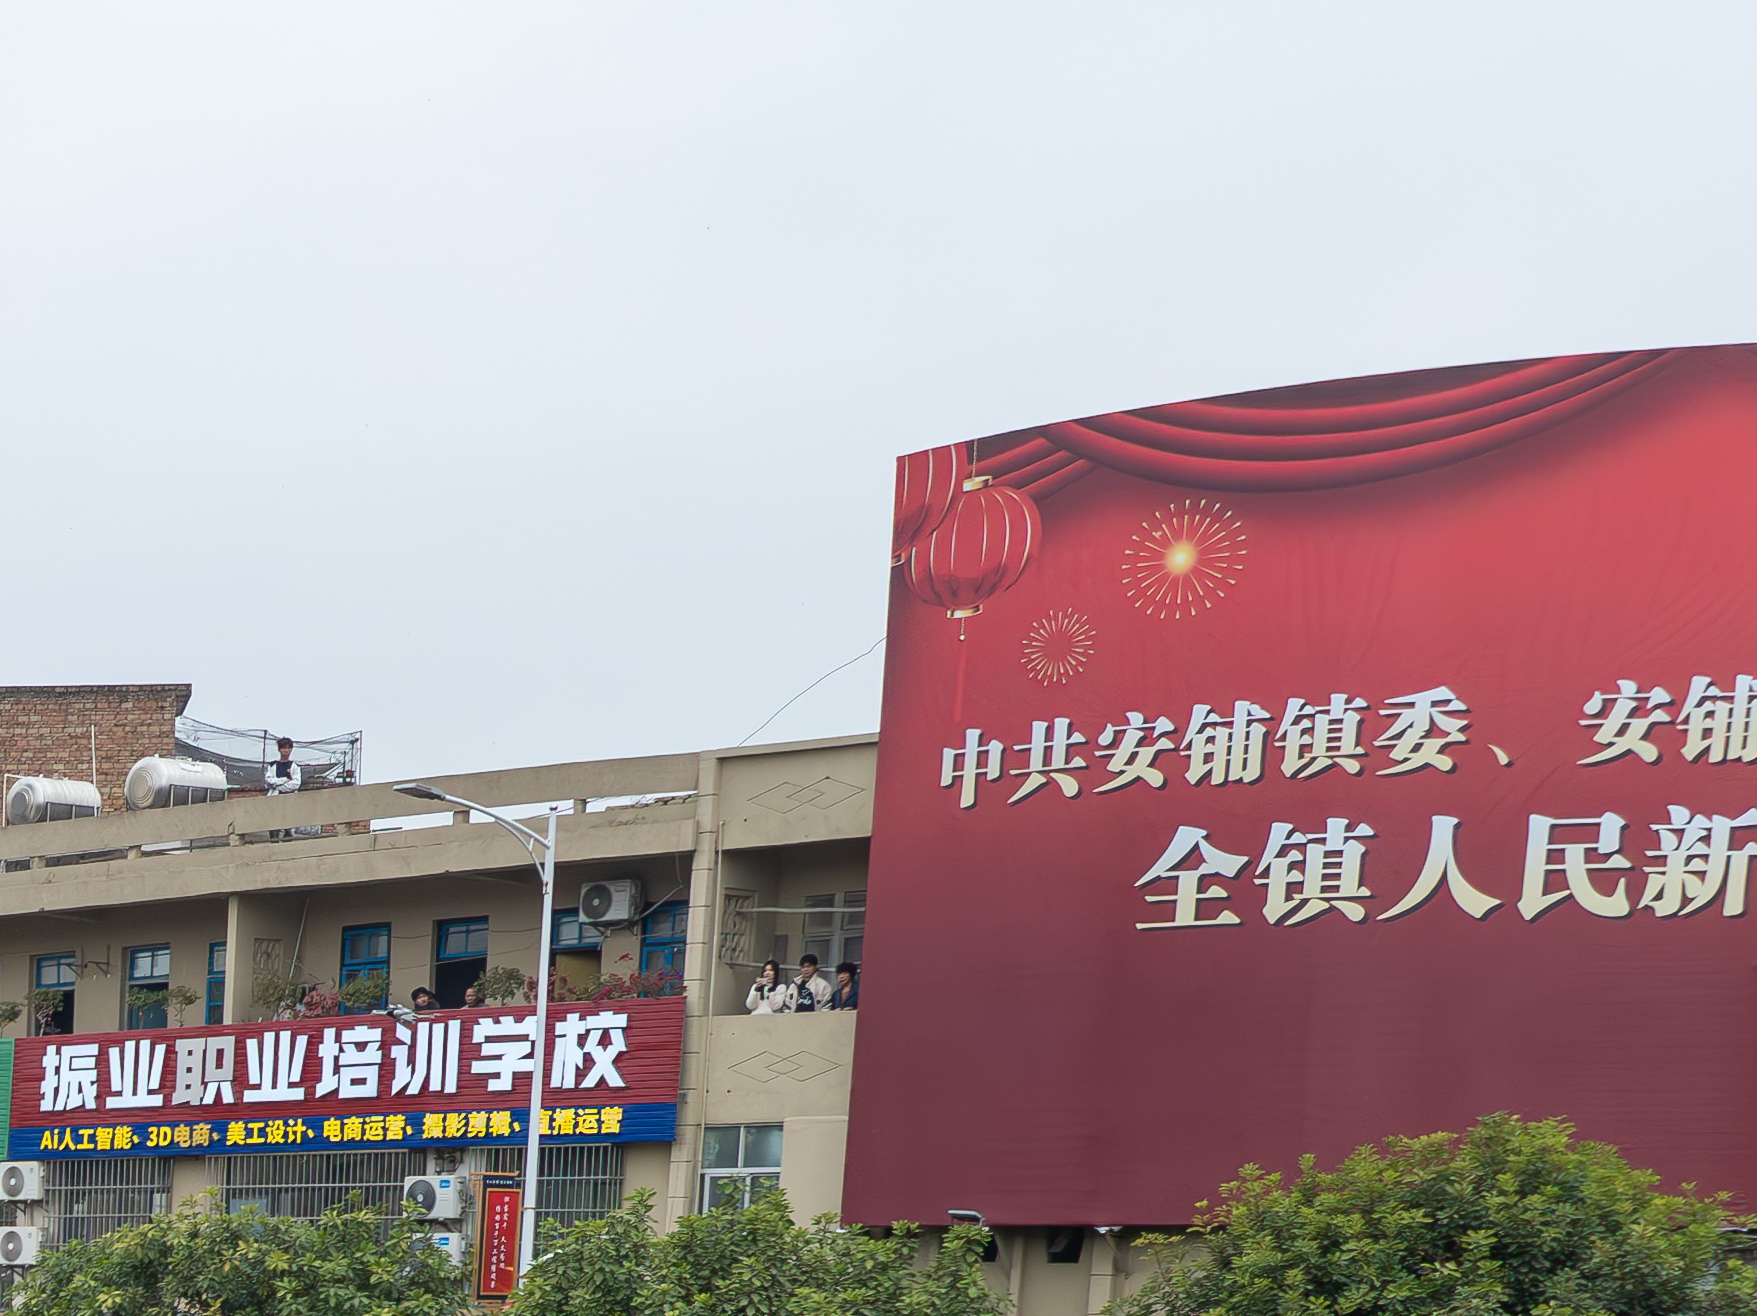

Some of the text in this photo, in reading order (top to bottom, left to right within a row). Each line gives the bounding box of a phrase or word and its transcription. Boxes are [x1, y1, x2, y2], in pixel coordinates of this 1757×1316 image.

[1134, 804, 1757, 930] 全镇人民新
[40, 1012, 629, 1112] 振业职业培训学校
